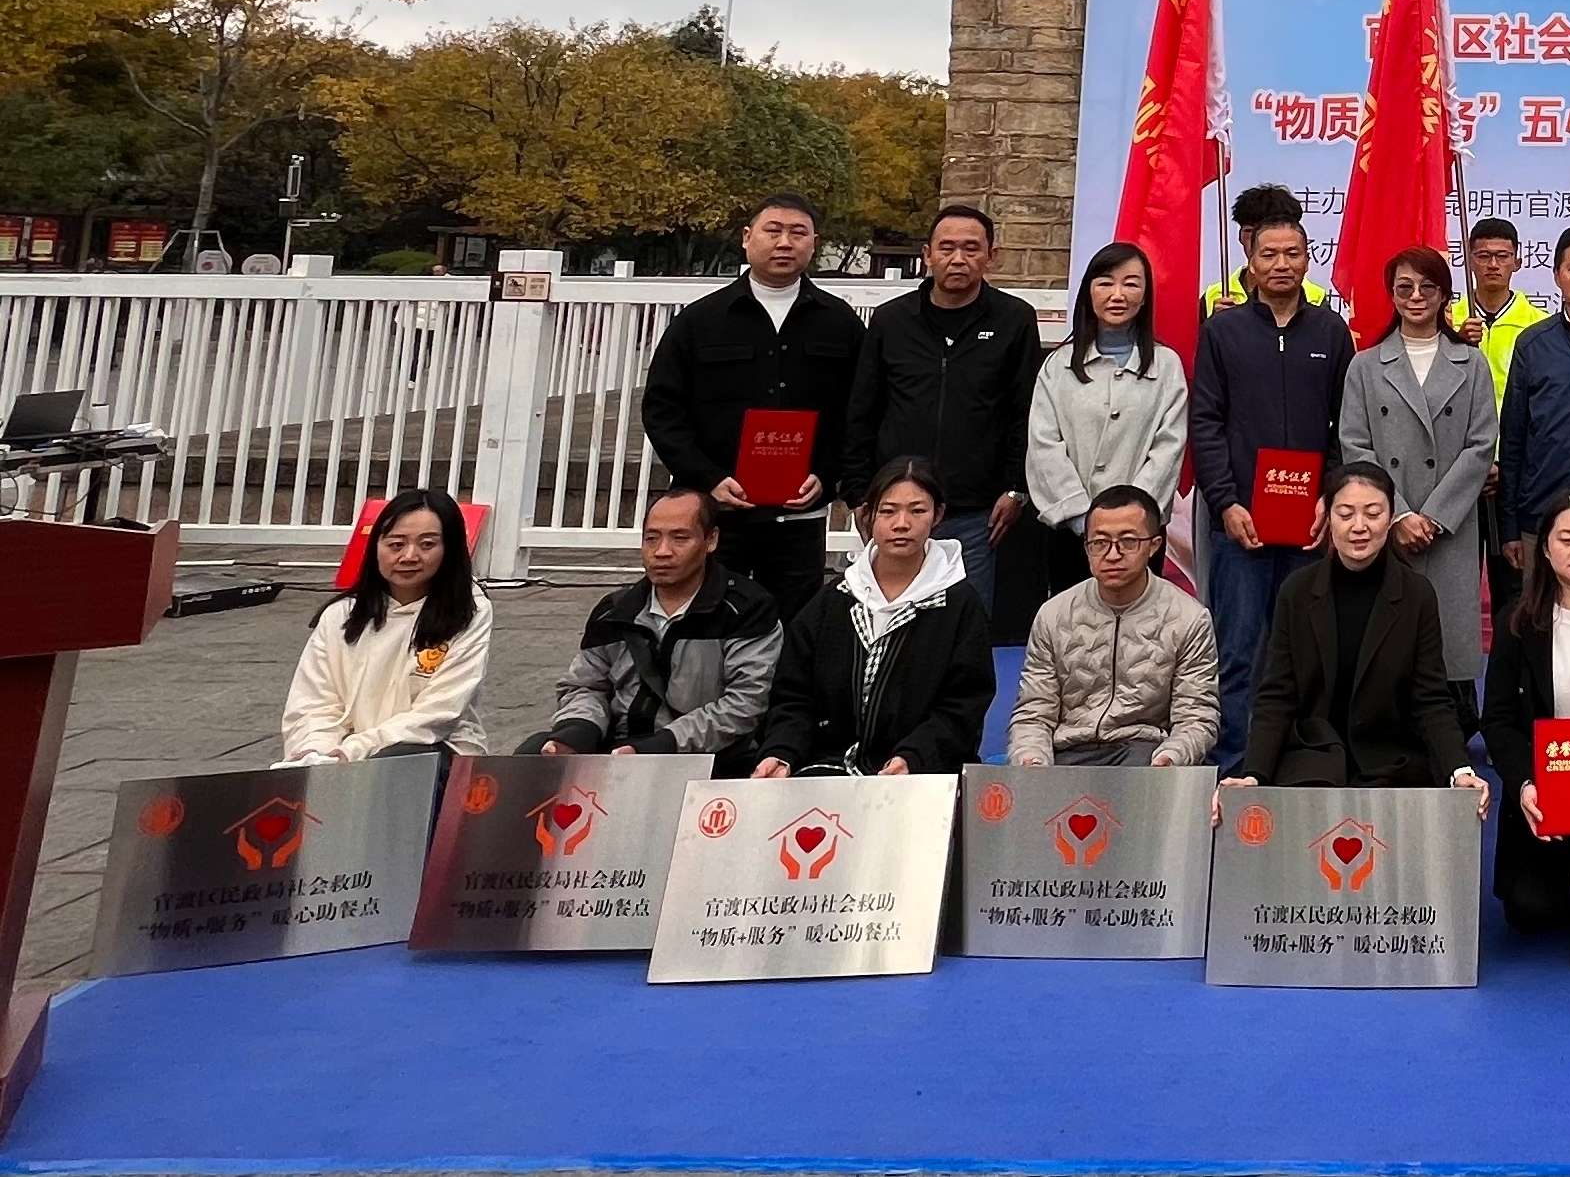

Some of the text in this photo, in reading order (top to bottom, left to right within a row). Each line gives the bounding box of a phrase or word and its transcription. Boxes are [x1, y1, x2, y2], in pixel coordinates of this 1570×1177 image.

[464, 869, 647, 890] 官渡区民政局社会救助
[990, 879, 1168, 900] 官渡区民政局社会救助
[705, 893, 896, 918] 官渡区民政局社会救助
[1254, 904, 1437, 925] 官渡区民政局社会救助
